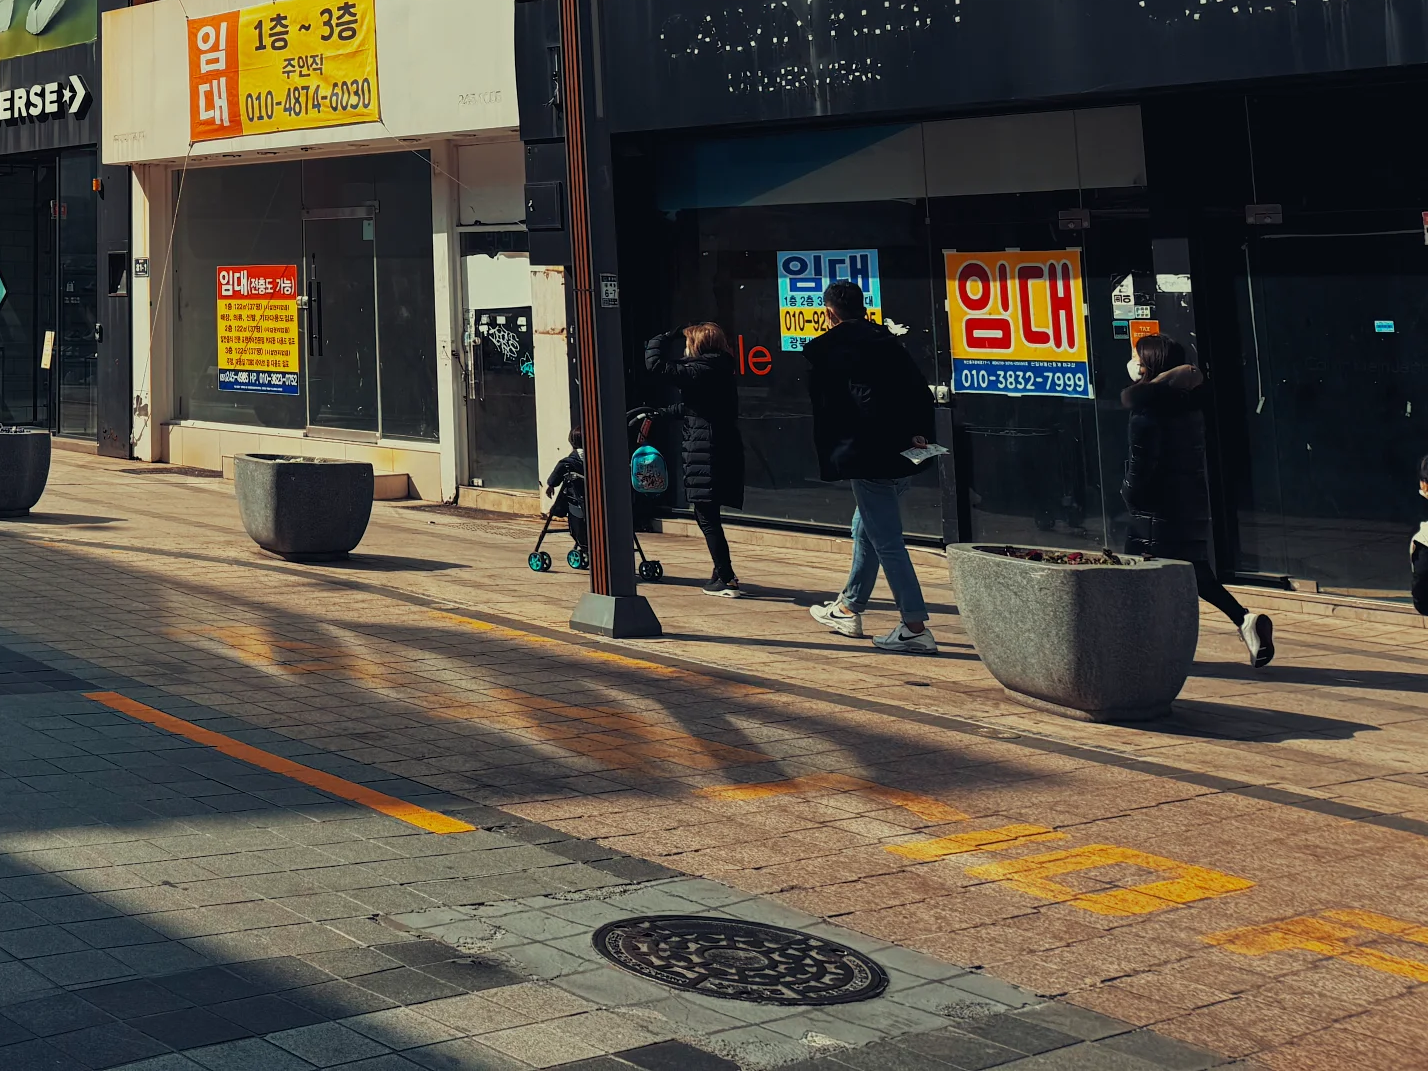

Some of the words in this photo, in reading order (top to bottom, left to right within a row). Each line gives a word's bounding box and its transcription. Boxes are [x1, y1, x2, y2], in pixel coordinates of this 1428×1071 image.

[253, 13, 290, 52] 1층
[319, 1, 359, 43] 3층
[281, 52, 325, 80] 주인직
[245, 76, 372, 124] 010-4874-6030
[781, 254, 871, 293] 임대
[784, 295, 798, 307] 1층
[800, 295, 814, 307] 2층
[957, 260, 1078, 353] 임대
[961, 369, 1085, 392] 010-3832-7999
